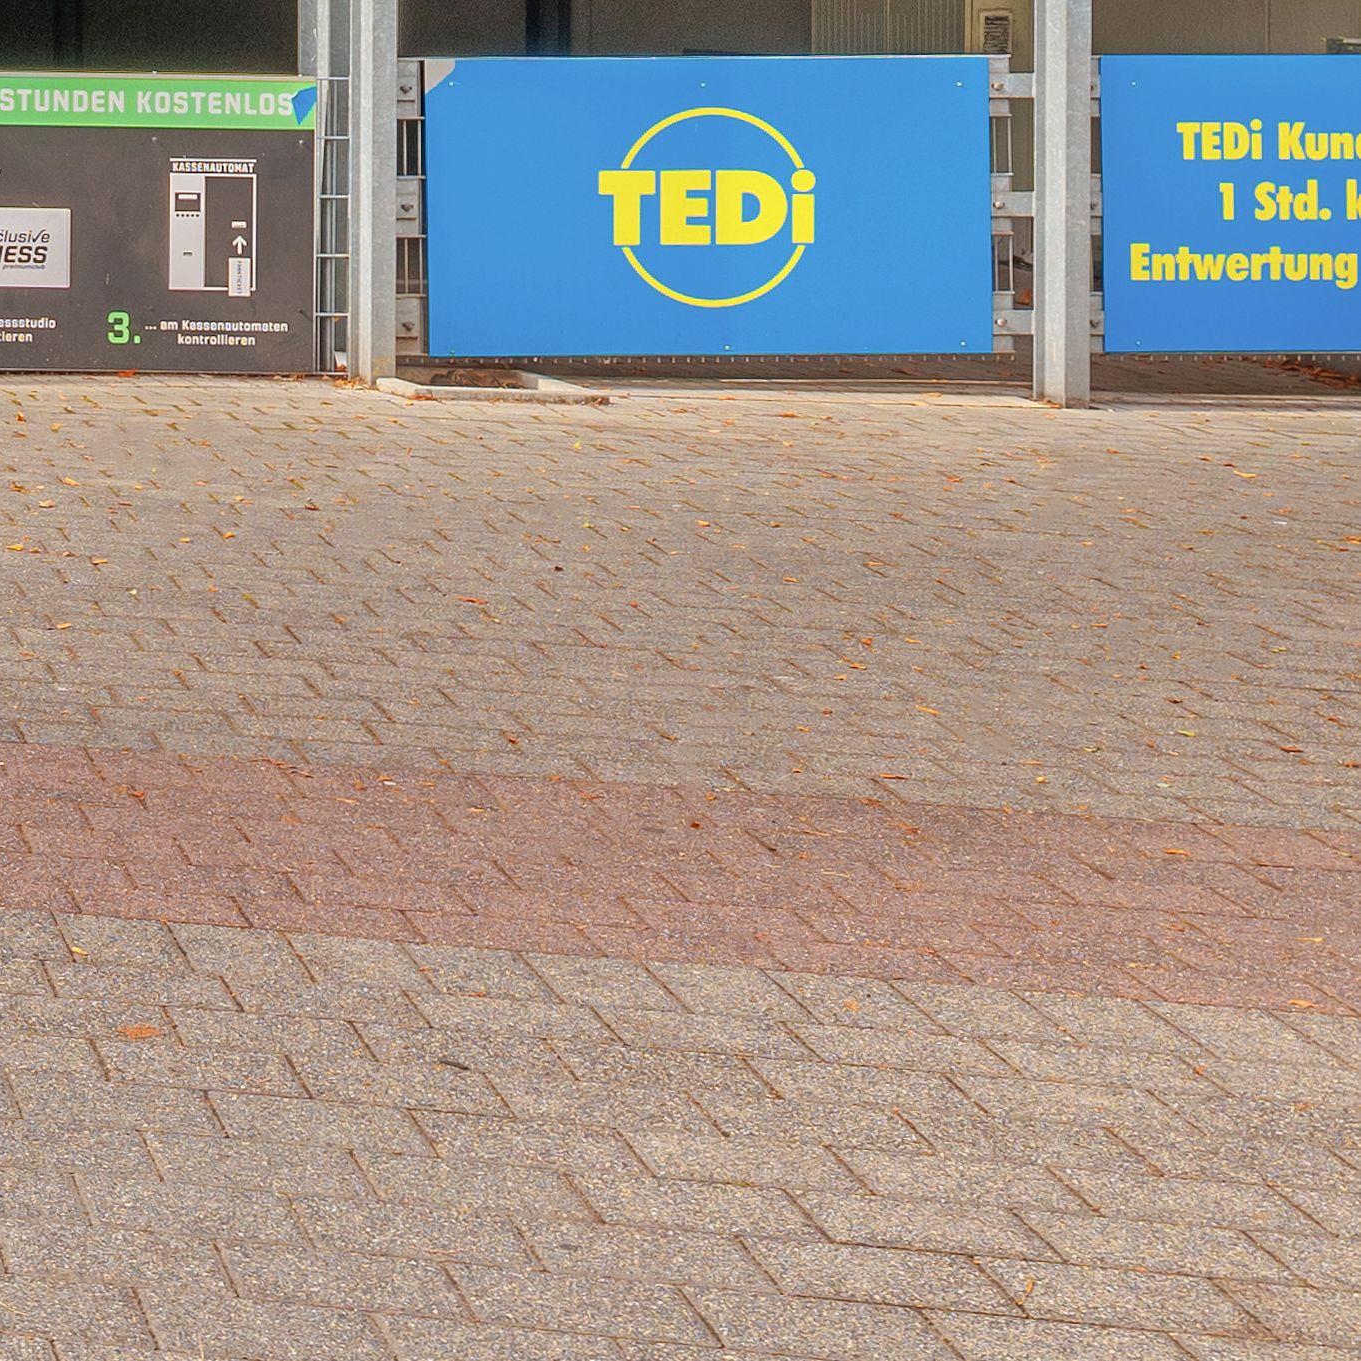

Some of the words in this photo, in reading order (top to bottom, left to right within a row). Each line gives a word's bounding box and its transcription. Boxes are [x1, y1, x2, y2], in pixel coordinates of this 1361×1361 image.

[0, 88, 125, 113] STUNDEN
[137, 91, 293, 115] KOSTENLOS
[1176, 118, 1263, 160] TEDi
[1278, 121, 1361, 161] Kun
[172, 162, 255, 173] KASSENAUTOMAT
[598, 169, 816, 246] TEDi
[1219, 182, 1235, 221] 1
[1254, 179, 1332, 221] Std.
[1130, 243, 1358, 290] Entwertung
[107, 311, 141, 344] 3.
[160, 321, 178, 331] am
[181, 319, 289, 332] Kassenautomaten
[177, 334, 256, 346] kontrollieren
